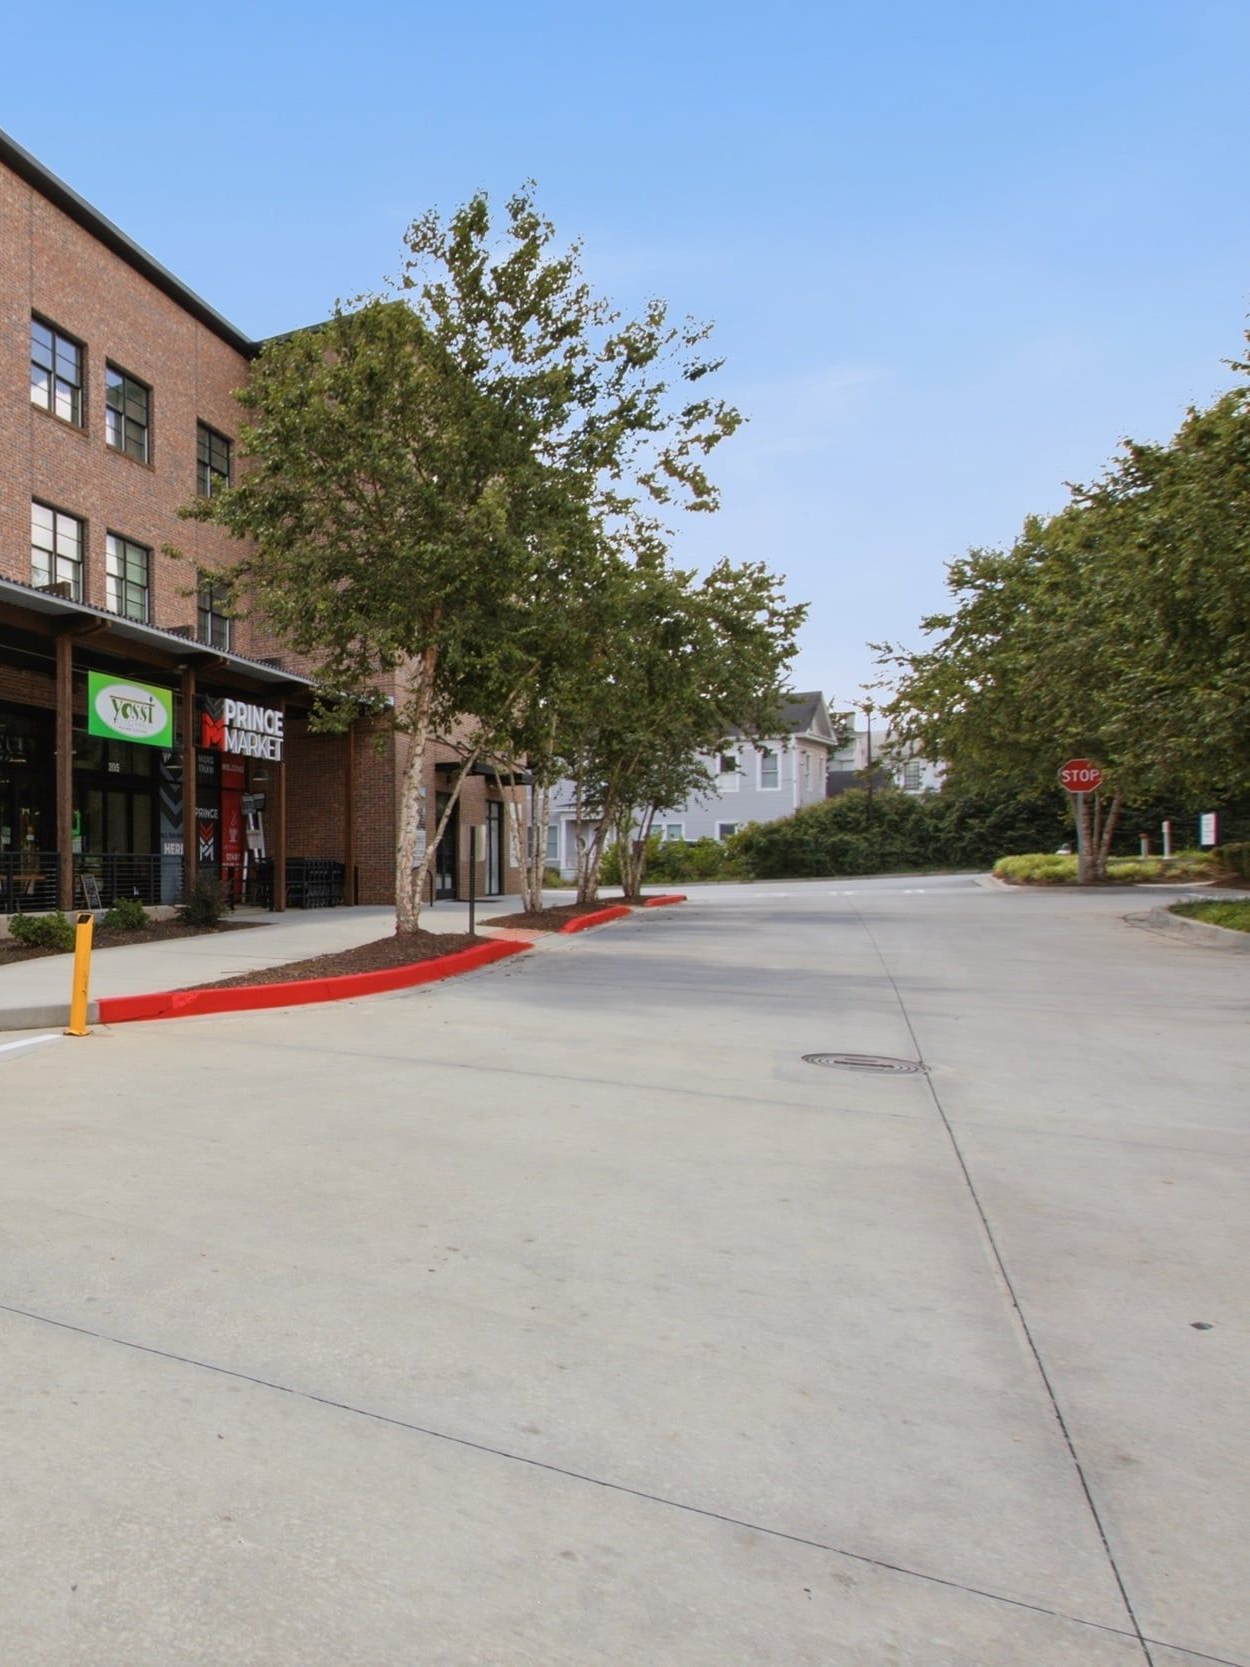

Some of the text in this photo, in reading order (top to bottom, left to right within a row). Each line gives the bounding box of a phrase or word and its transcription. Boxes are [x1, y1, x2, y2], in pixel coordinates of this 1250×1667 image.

[224, 698, 284, 738] PRINCE
[224, 726, 284, 761] MARKET
[1061, 769, 1100, 783] STOP
